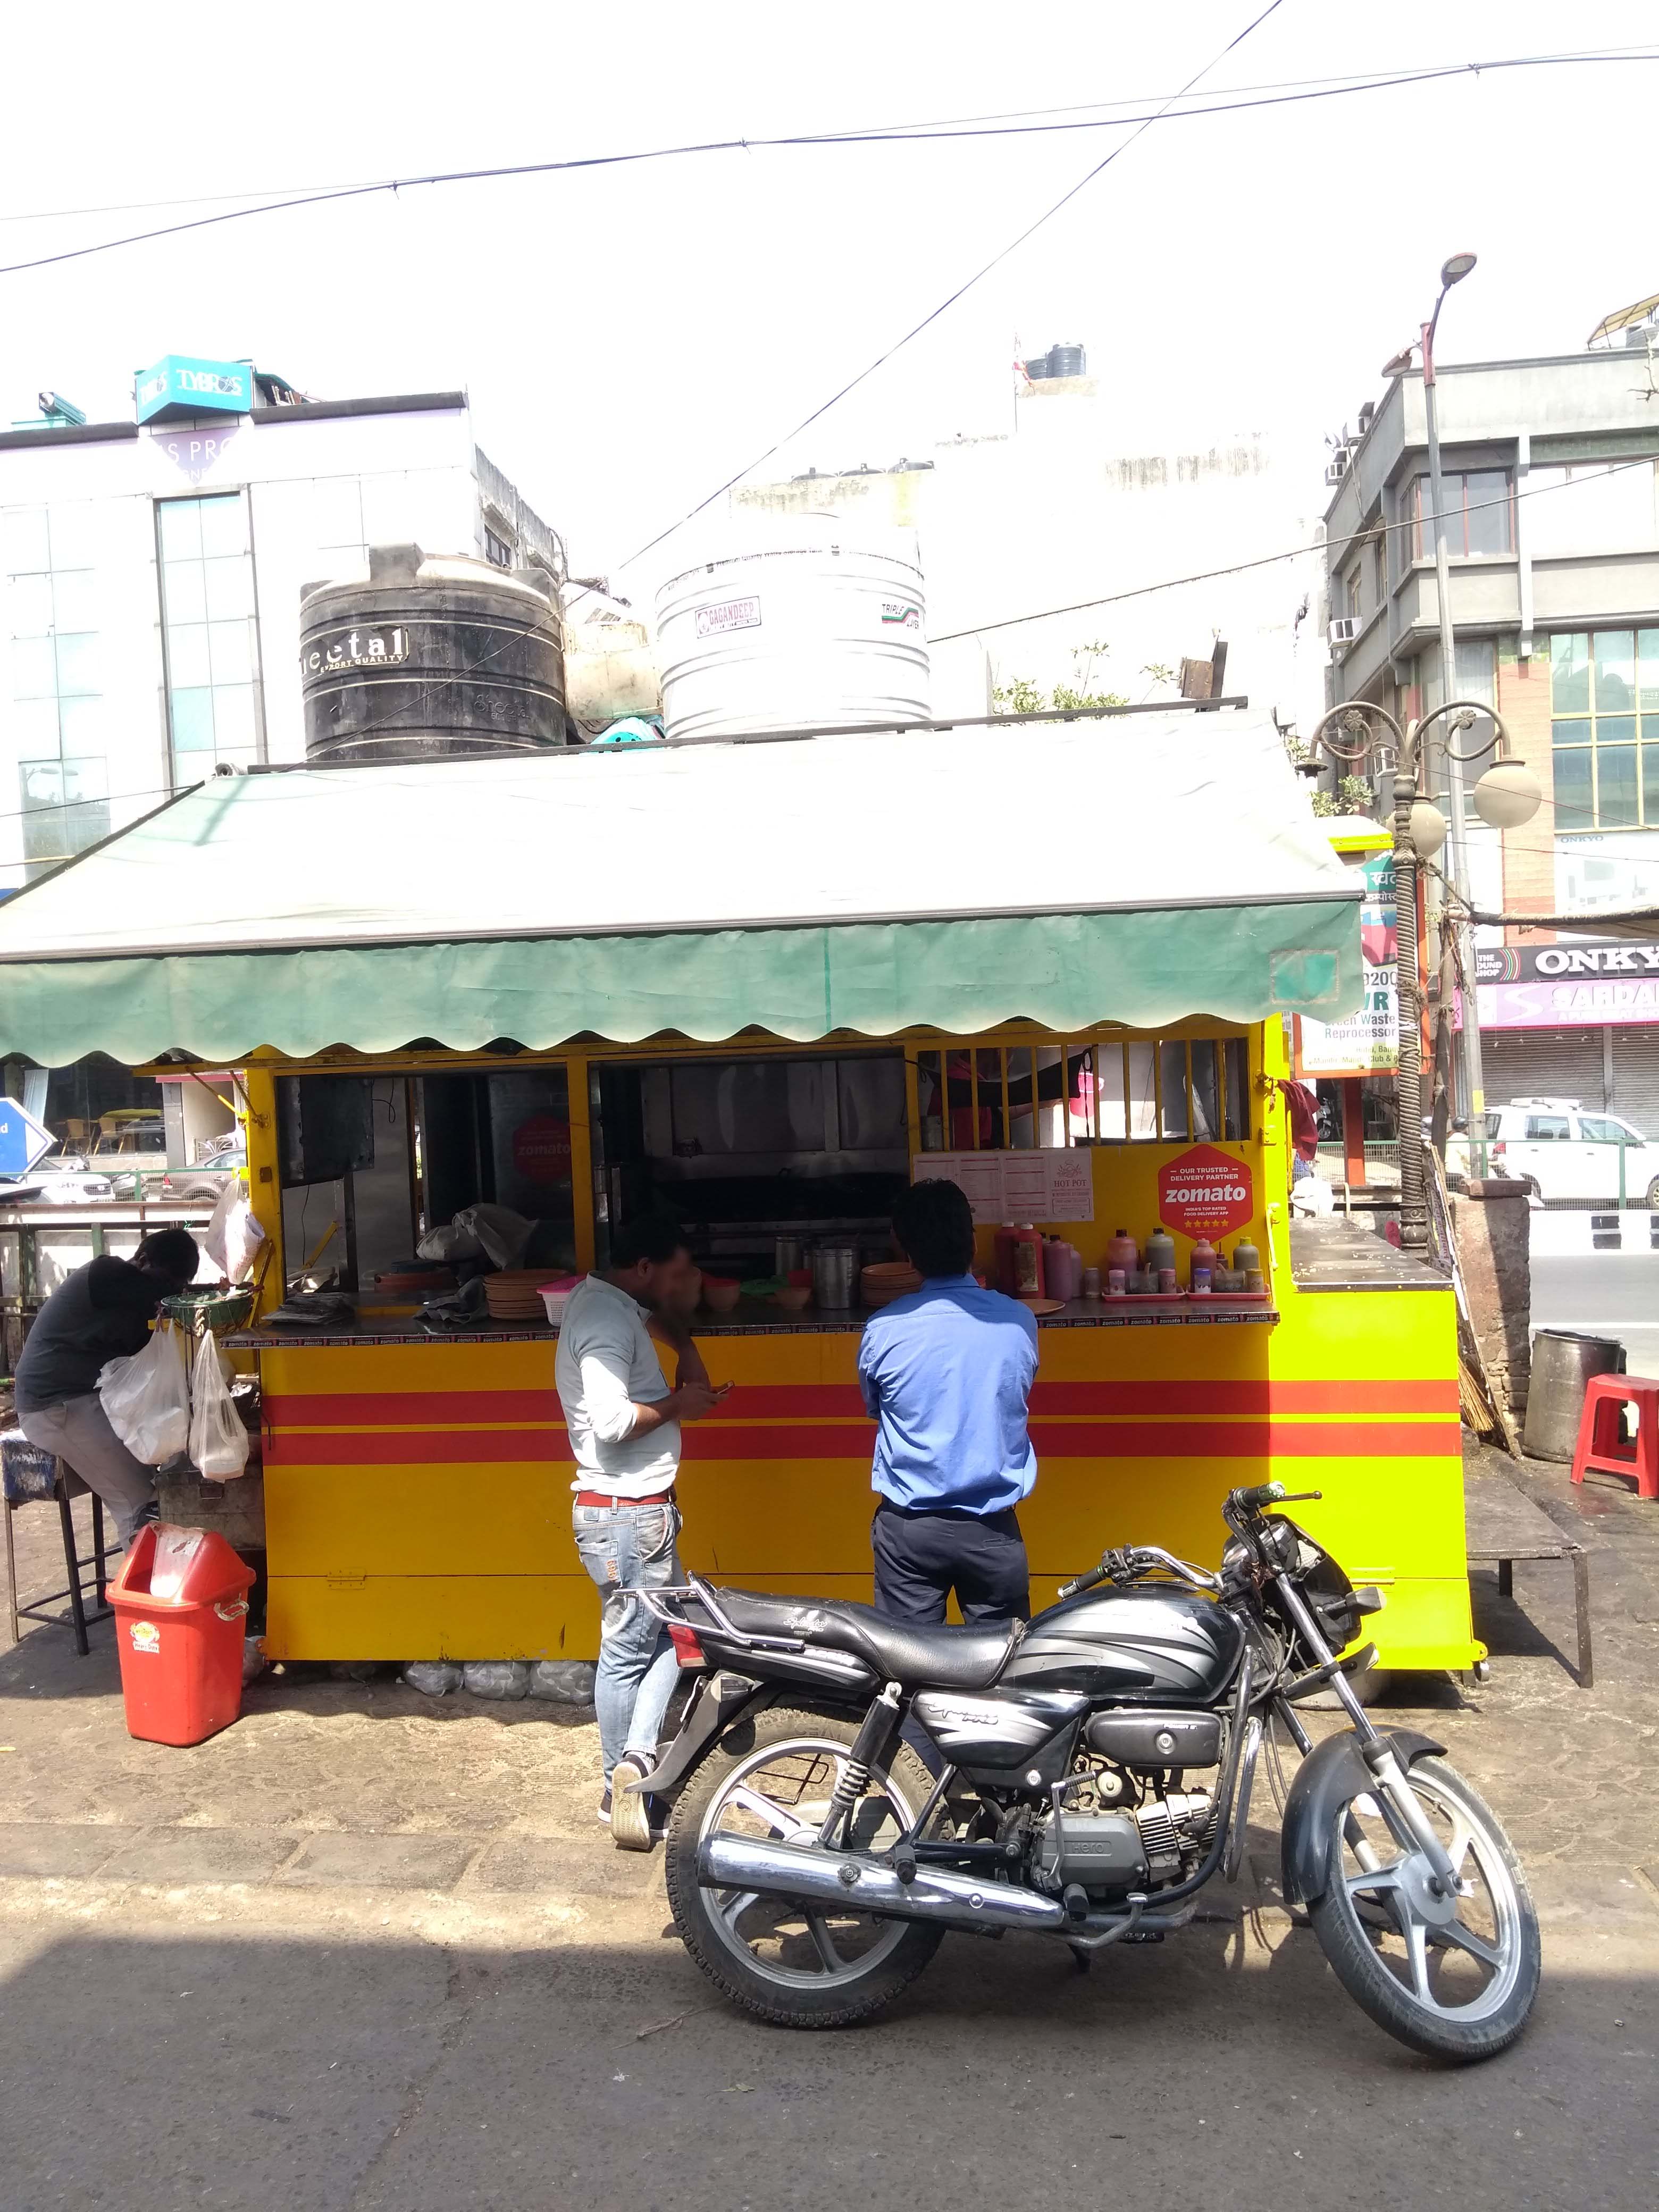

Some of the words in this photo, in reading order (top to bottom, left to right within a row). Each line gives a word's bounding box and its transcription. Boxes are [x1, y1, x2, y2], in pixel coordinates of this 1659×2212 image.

[709, 601, 754, 625] GAGANDEEP
[882, 604, 904, 615] TRIPLE
[355, 655, 403, 665] QUALITY
[1361, 1013, 1395, 1025] Waste
[1325, 1027, 1396, 1042] Reprocessor
[1165, 1184, 1246, 1203] zomato
